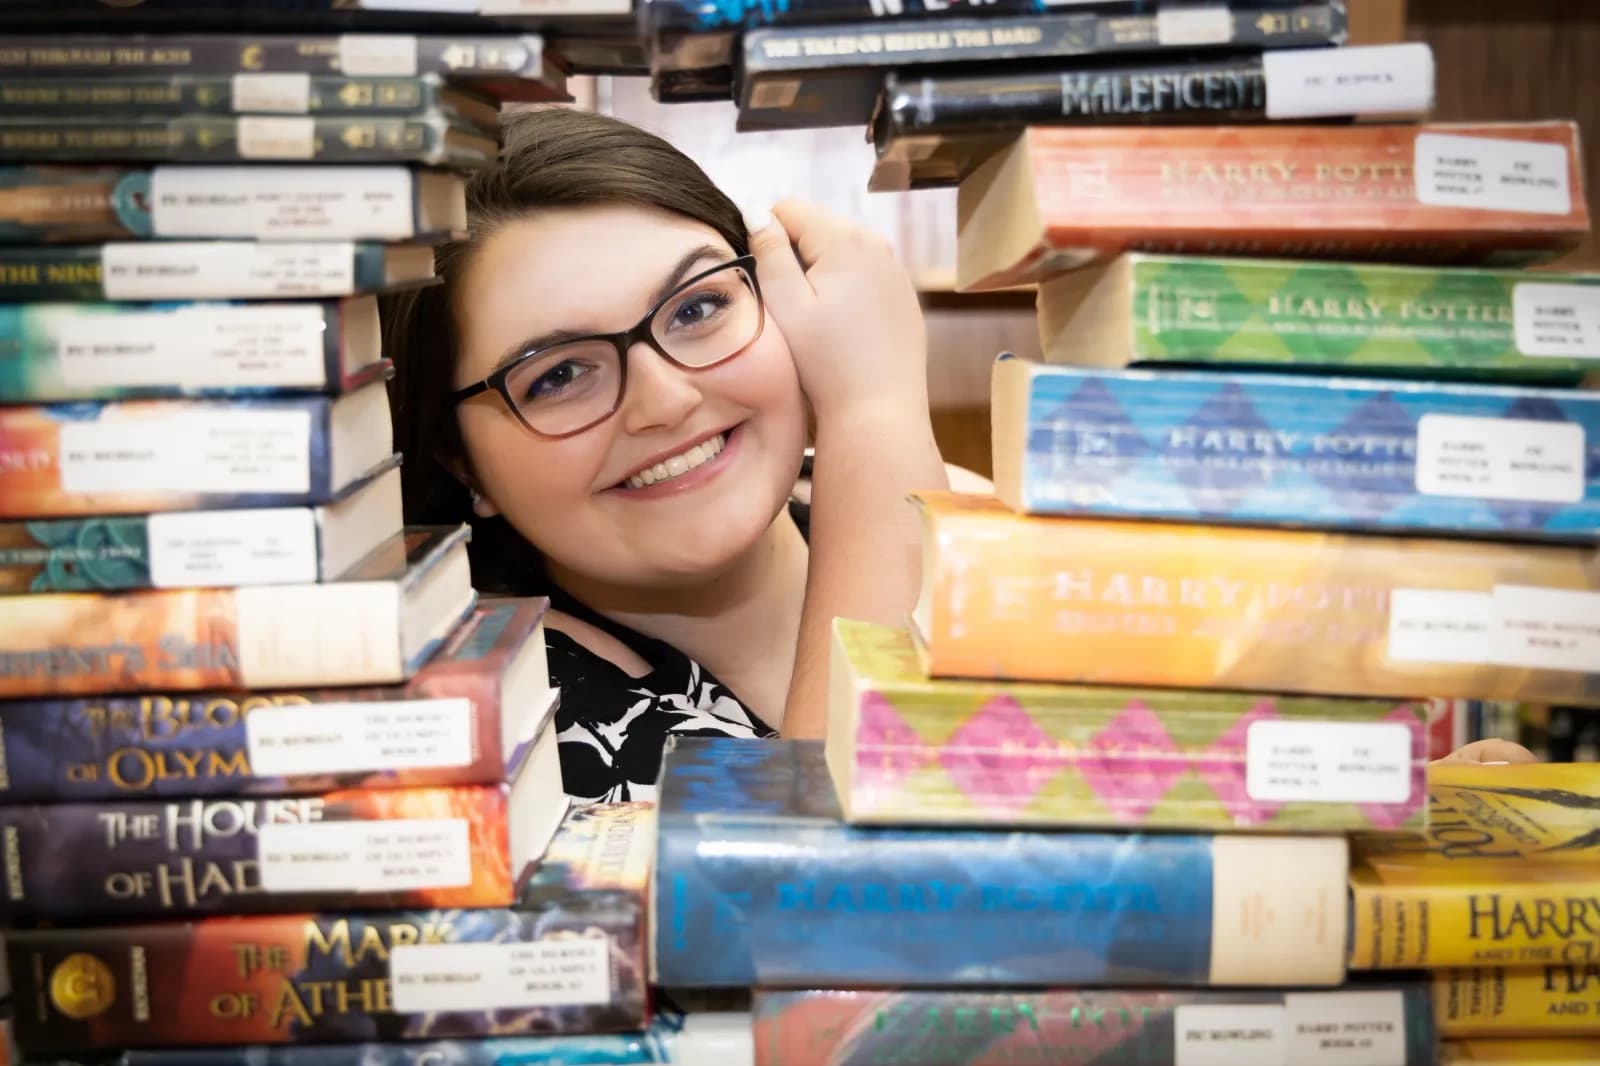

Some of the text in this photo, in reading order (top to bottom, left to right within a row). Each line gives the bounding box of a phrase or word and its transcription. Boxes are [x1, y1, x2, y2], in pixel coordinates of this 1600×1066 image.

[1060, 68, 1266, 117] MALEFICENT
[1159, 159, 1298, 185] HARRY
[1268, 294, 1387, 321] HARRY
[1168, 425, 1303, 453] HARRY
[1051, 570, 1248, 610] HARRY
[97, 811, 159, 849] THE
[104, 872, 152, 898] OF
[776, 878, 964, 914] HARRY
